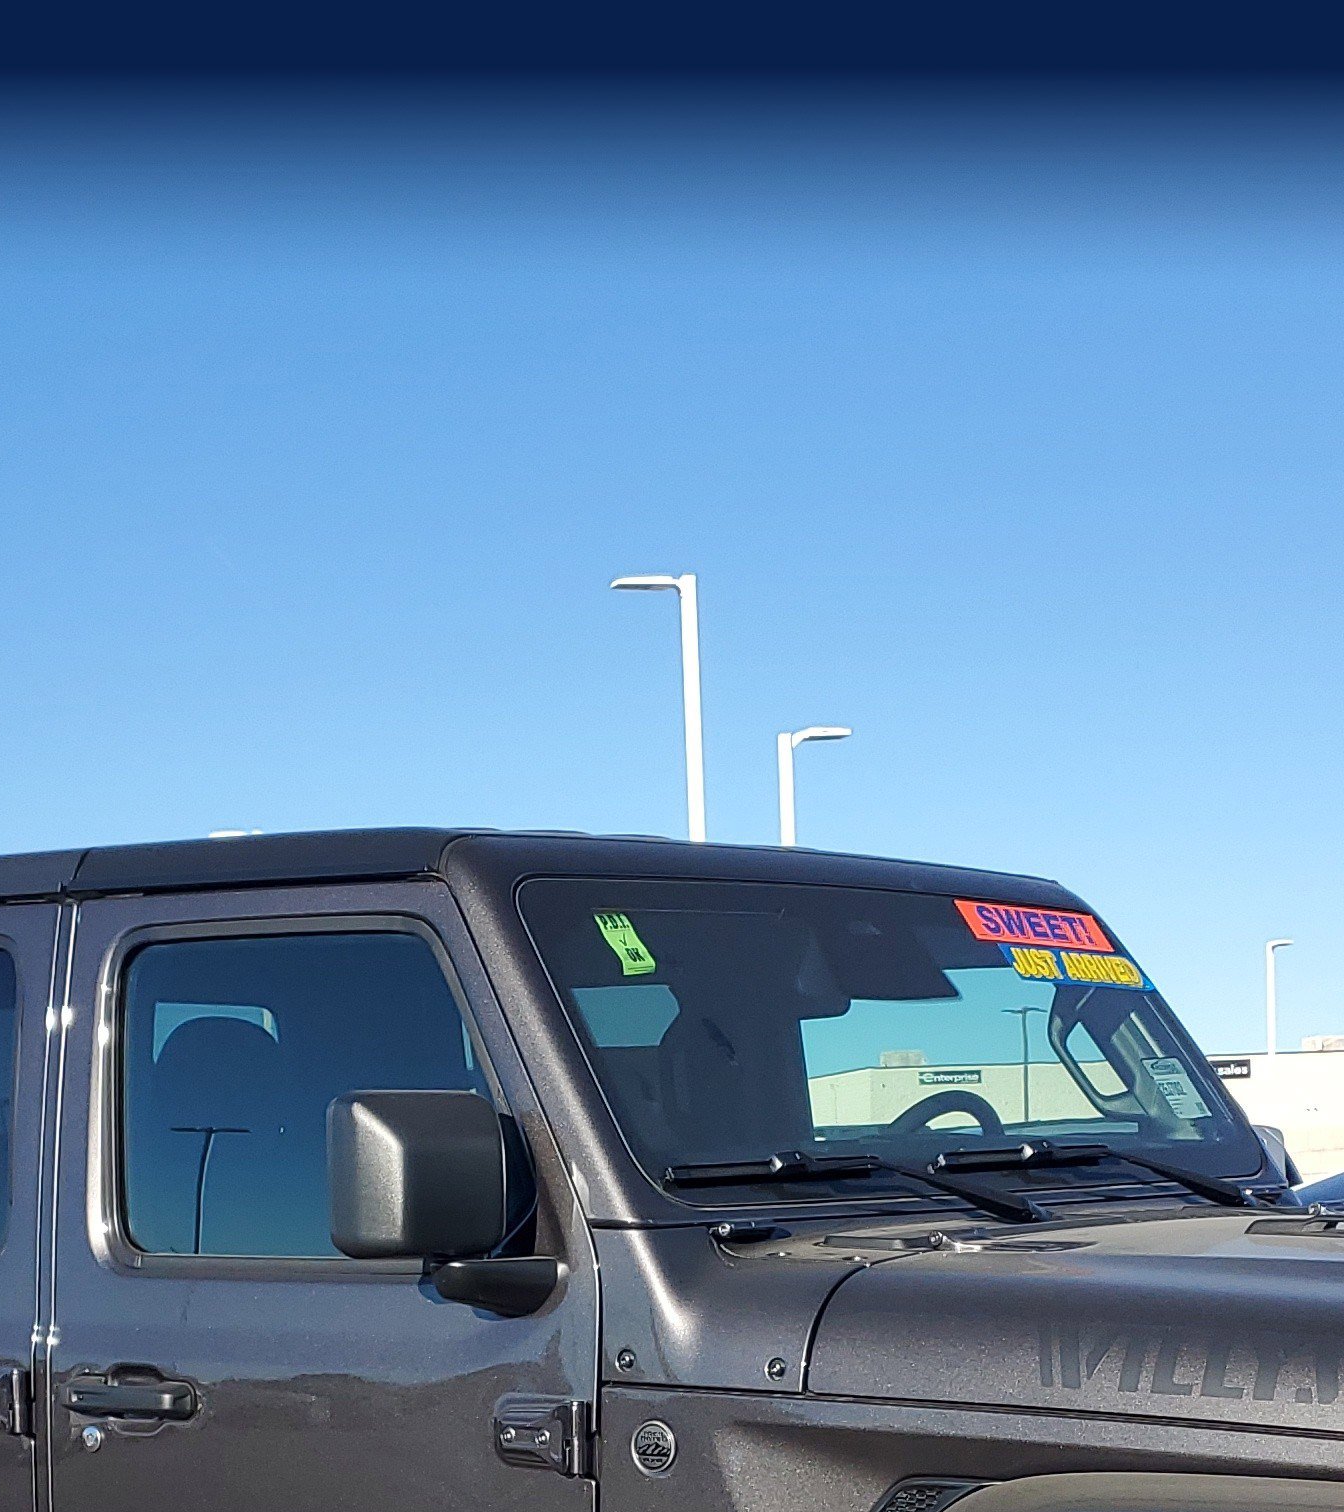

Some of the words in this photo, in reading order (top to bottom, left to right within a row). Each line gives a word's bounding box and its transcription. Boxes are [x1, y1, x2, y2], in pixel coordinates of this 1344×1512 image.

[597, 914, 630, 931] P.D.I.
[976, 905, 1096, 947] SWEET!
[624, 947, 646, 963] OK
[1010, 947, 1064, 980] JUST
[1060, 951, 1144, 989] ARRIVED
